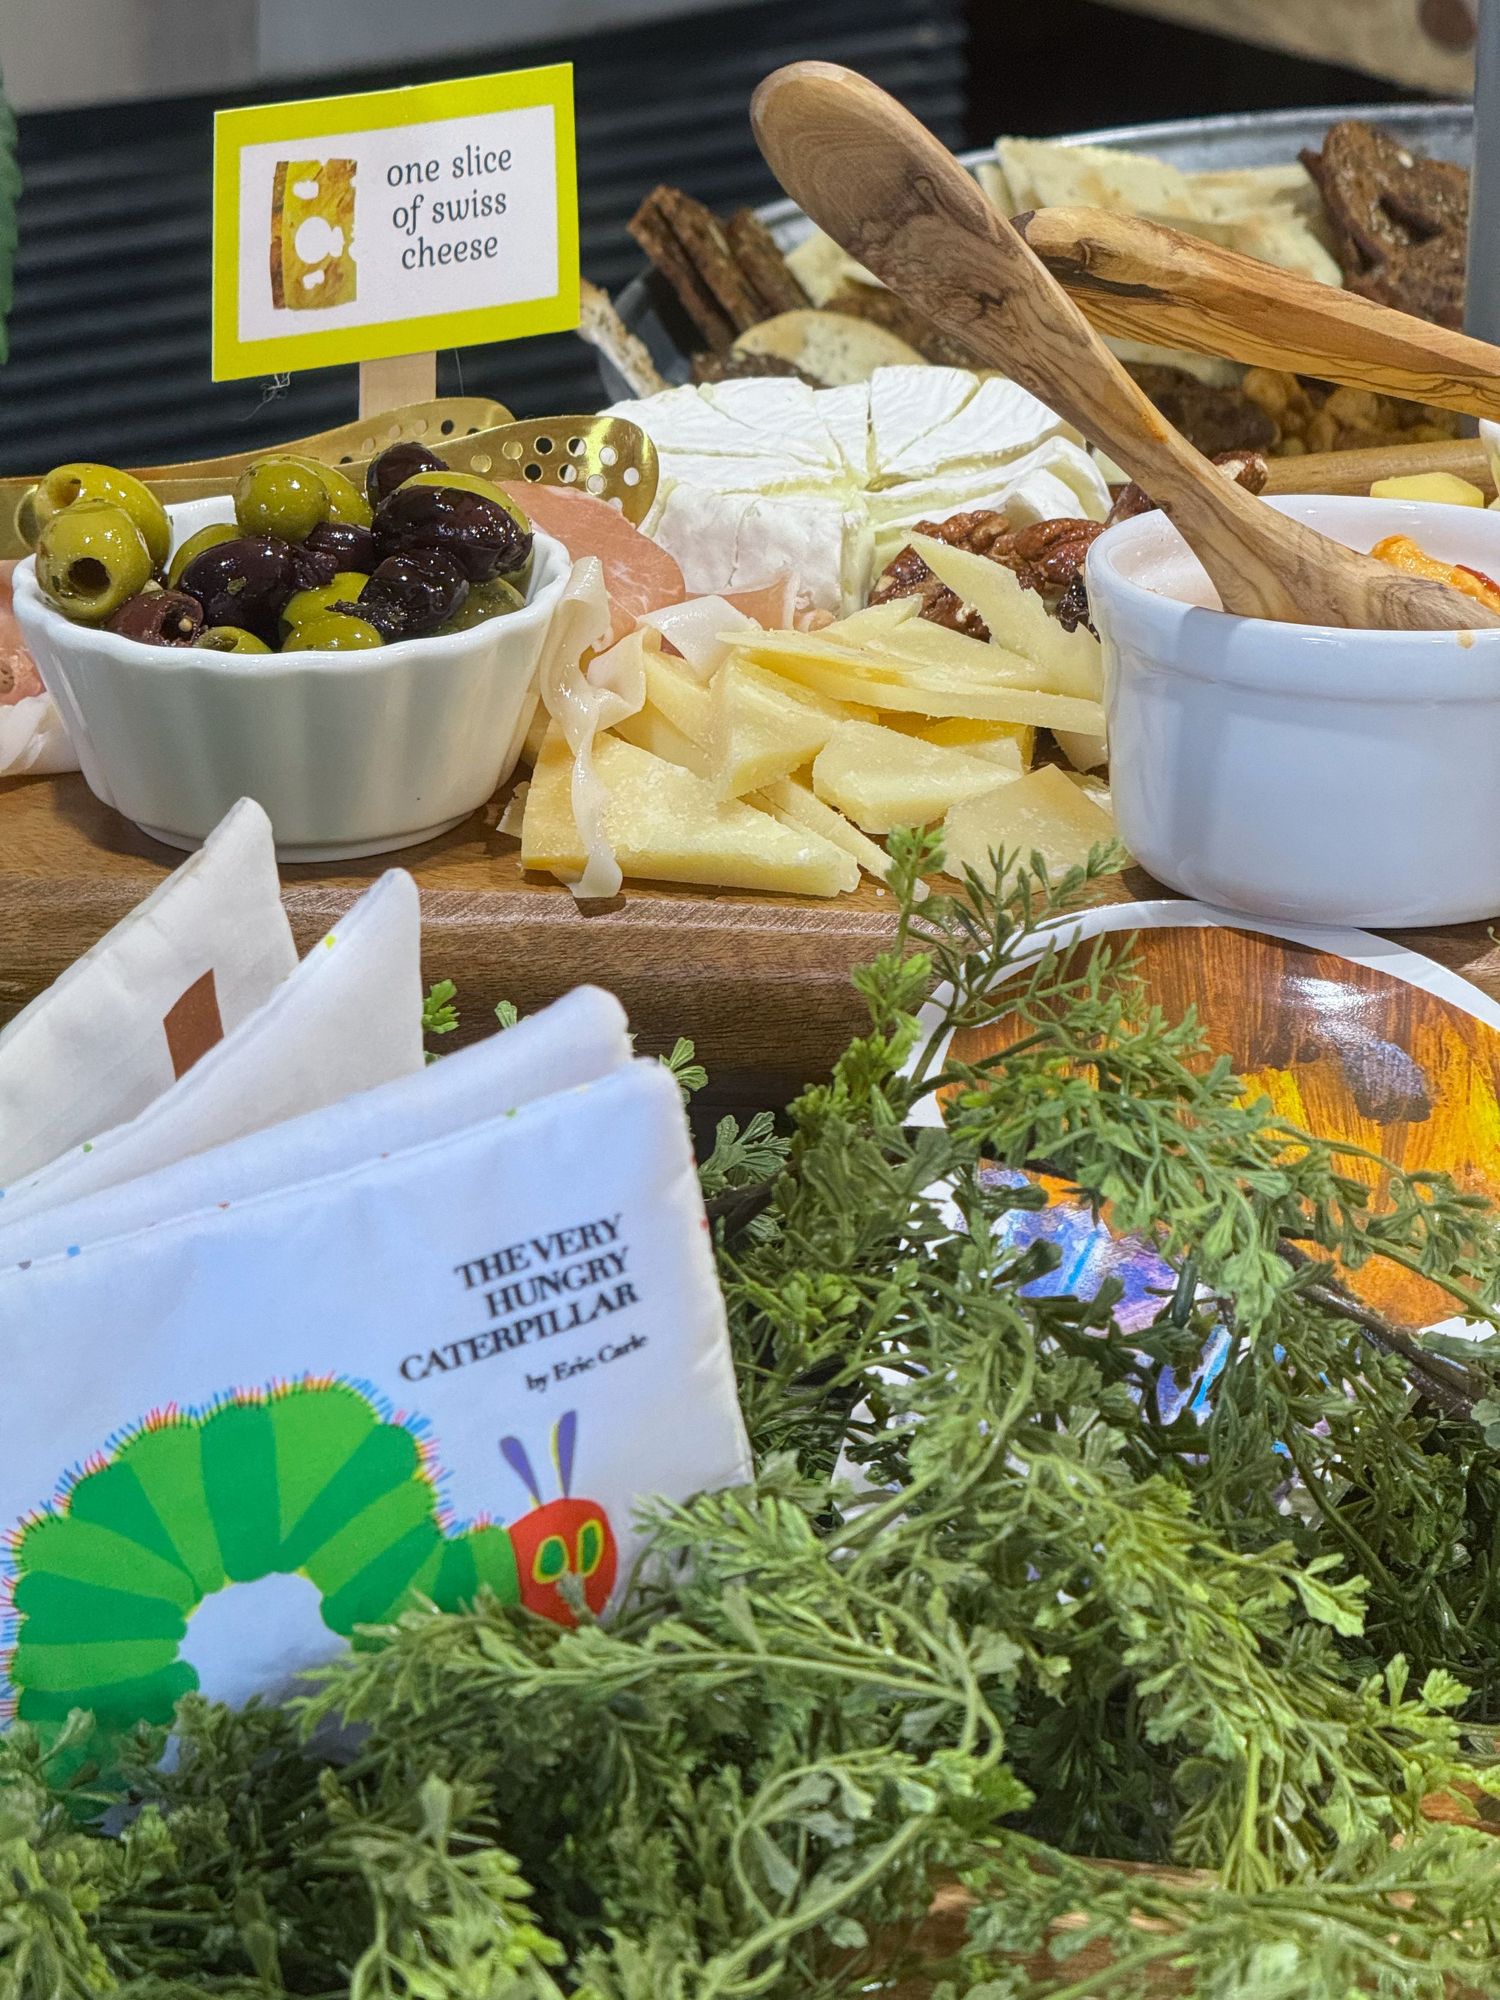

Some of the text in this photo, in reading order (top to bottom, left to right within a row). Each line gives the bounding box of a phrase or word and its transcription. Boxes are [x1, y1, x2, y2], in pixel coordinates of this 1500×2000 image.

[386, 144, 513, 187] one slice
[392, 188, 507, 236] of swiss
[401, 235, 499, 270] cheese
[454, 1212, 622, 1291] THE VERY
[485, 1245, 629, 1319] HUNGRY
[399, 1281, 640, 1382] CATERPILLAR
[524, 1332, 648, 1393] by Eric Carle
